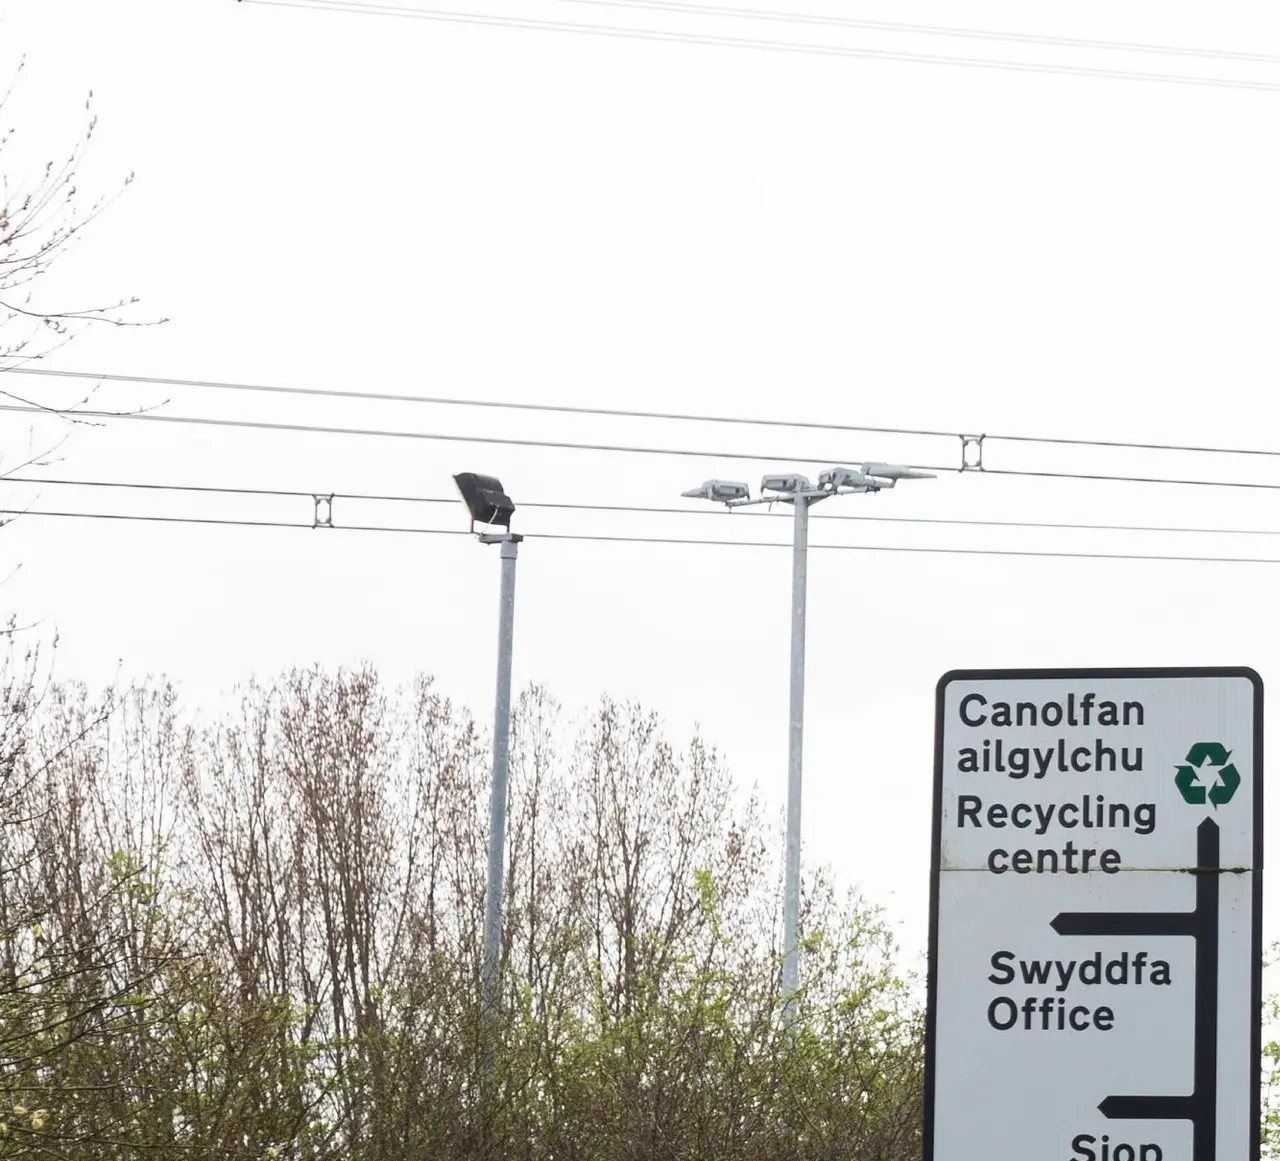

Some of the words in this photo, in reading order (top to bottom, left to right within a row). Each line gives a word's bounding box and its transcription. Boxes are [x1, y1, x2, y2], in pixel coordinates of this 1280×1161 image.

[958, 693, 1144, 728] Canolfan
[957, 738, 1143, 779] ailgylchu
[957, 795, 1157, 835] Recycling
[987, 841, 1122, 875] centre
[988, 951, 1172, 992] Swyddfa
[987, 997, 1115, 1032] Office
